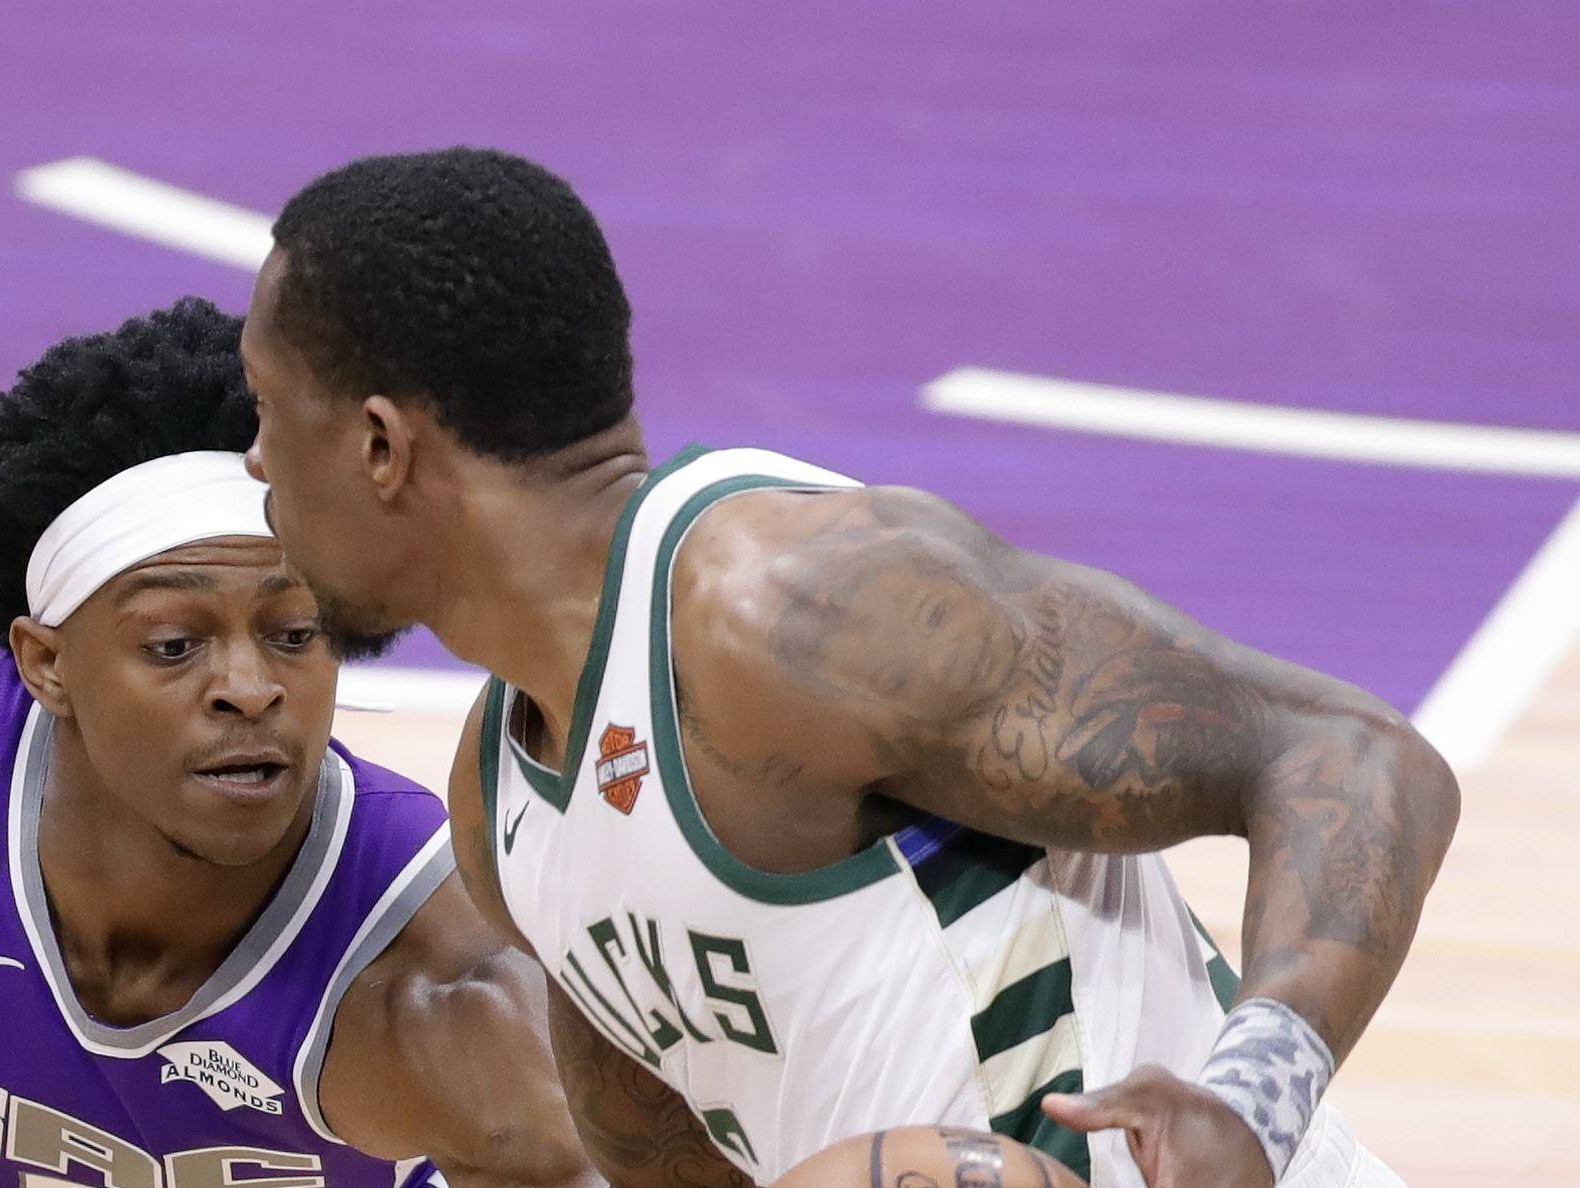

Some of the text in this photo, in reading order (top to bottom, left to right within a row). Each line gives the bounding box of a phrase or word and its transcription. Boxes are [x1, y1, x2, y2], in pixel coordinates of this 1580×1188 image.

[558, 909, 780, 1070] UCKS
[189, 1052, 259, 1089] DIAMOND
[209, 1049, 241, 1071] BLUE
[165, 1065, 278, 1113] ALMONDS
